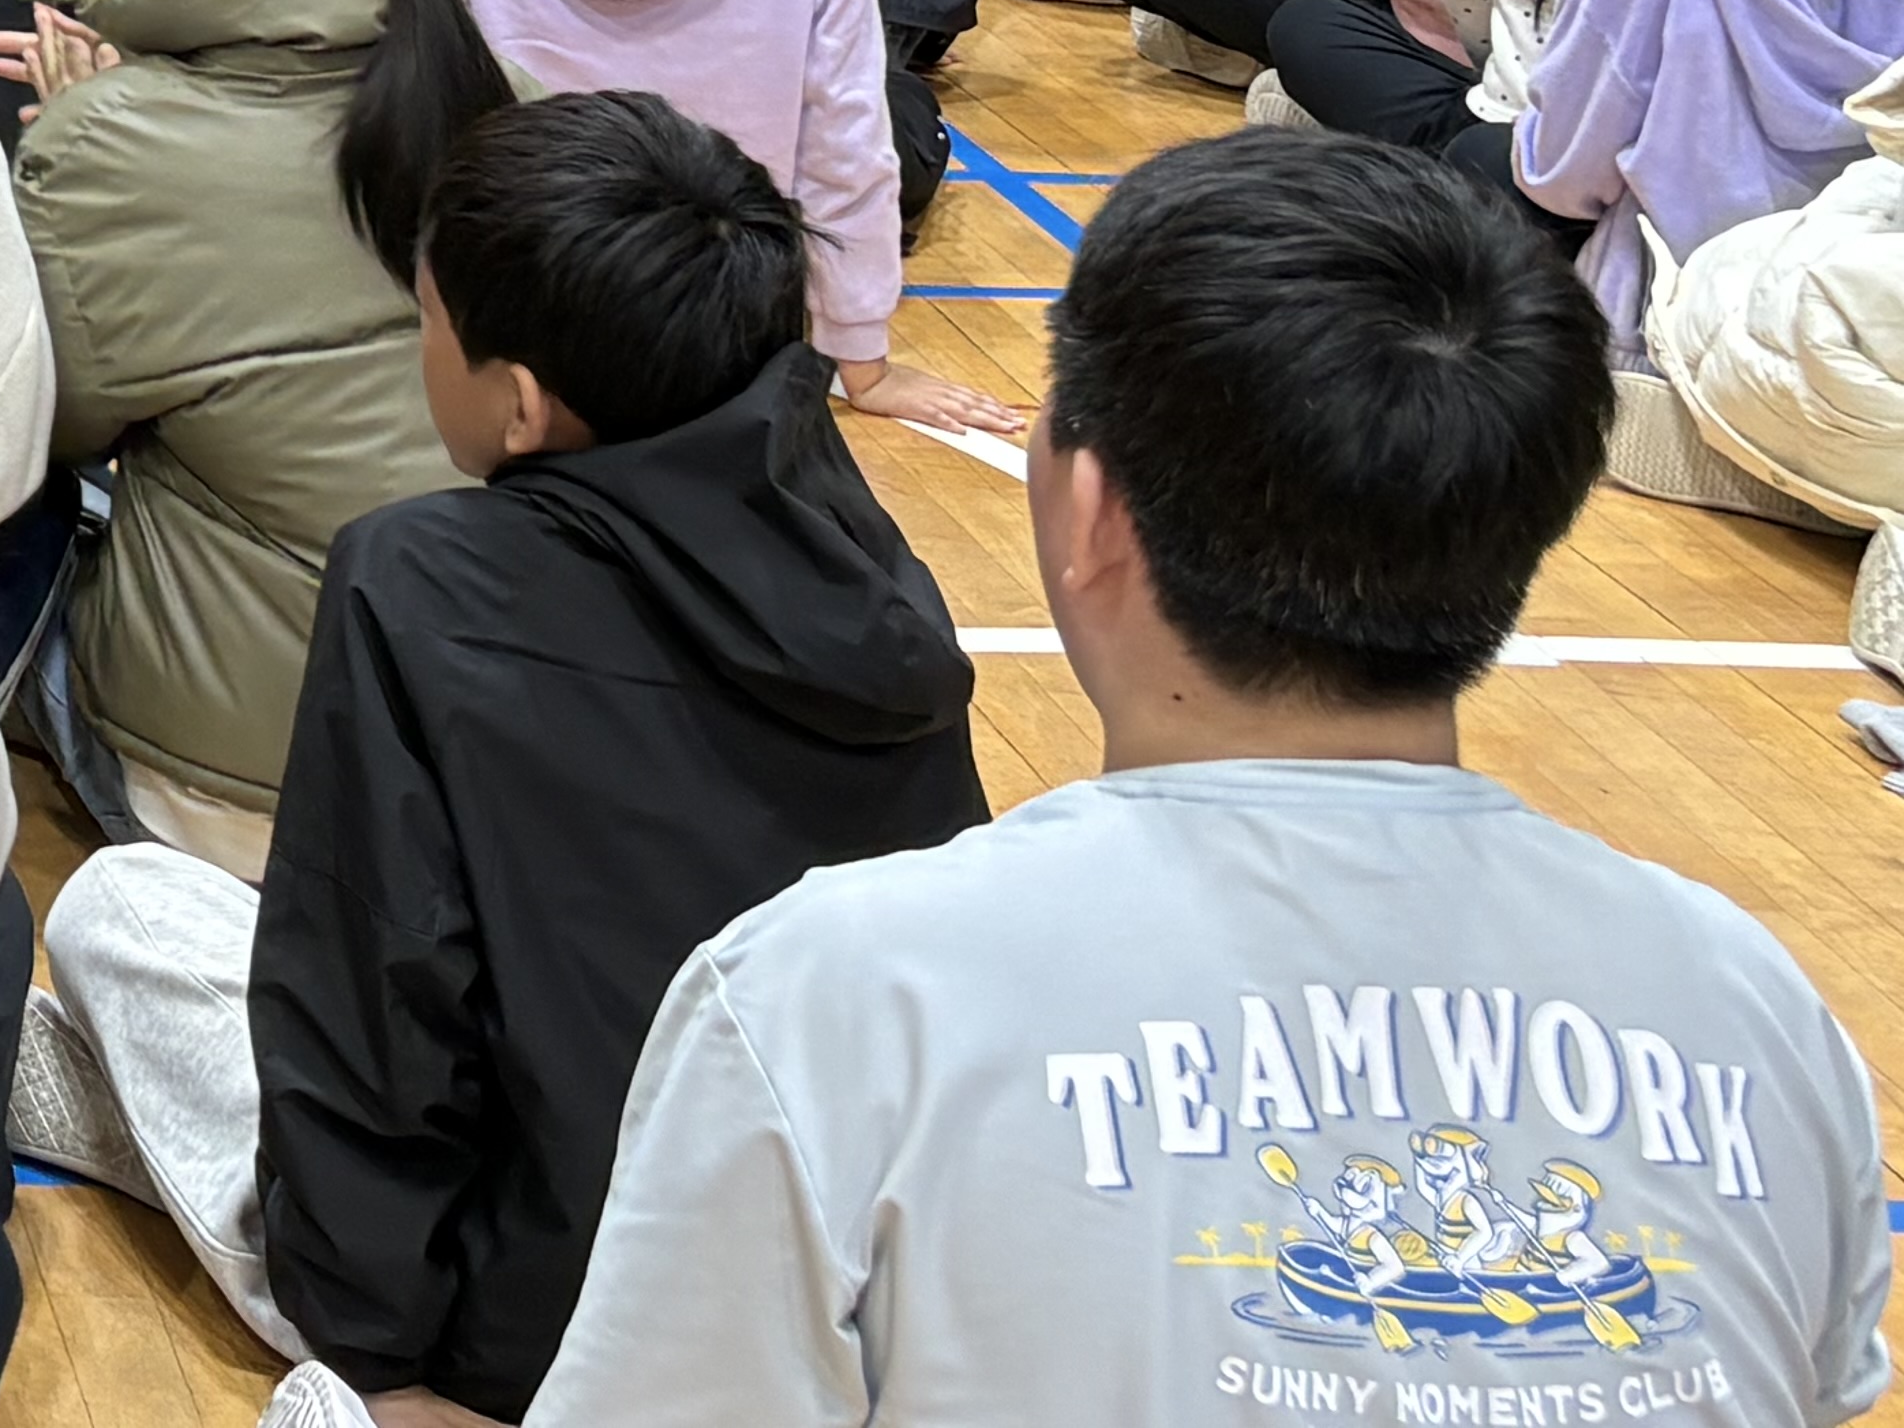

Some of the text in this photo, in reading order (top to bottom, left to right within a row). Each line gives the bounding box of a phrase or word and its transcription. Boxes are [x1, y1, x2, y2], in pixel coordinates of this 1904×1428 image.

[1046, 983, 1768, 1199] TEAMWORK
[1215, 1355, 1733, 1426] SUNNY MOMENTS CLUB
